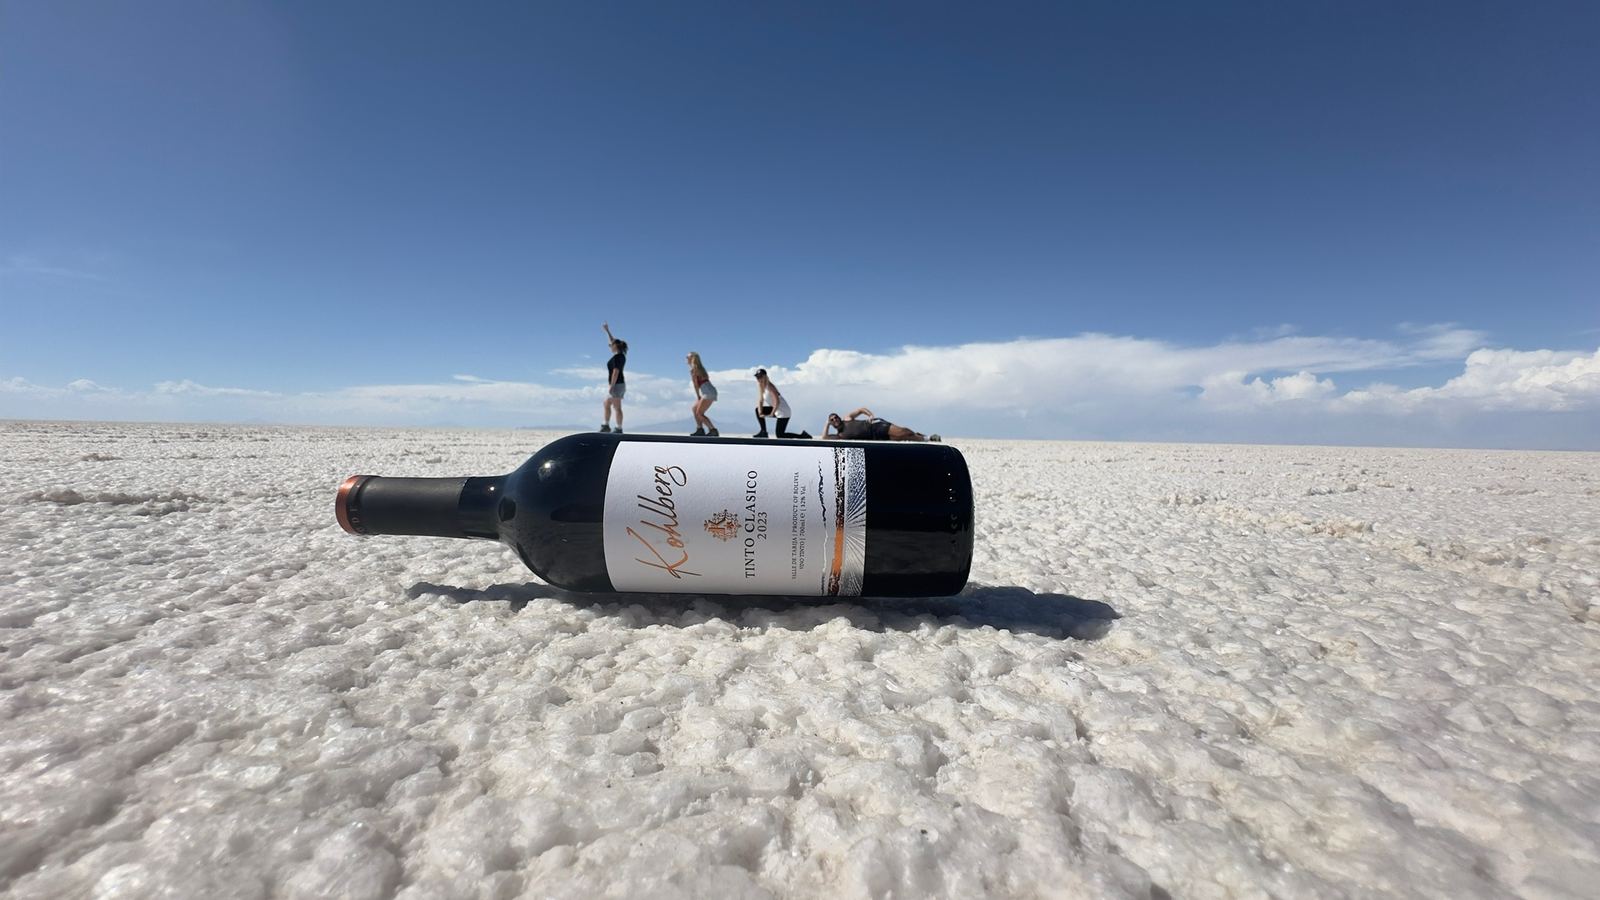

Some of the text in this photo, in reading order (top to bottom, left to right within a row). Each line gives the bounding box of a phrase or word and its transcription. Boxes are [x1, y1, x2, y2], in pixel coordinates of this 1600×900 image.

[626, 464, 702, 579] Kohlberg
[744, 470, 758, 579] TINTO CLASICO
[757, 511, 767, 540] 2023
[793, 494, 798, 504] OF
